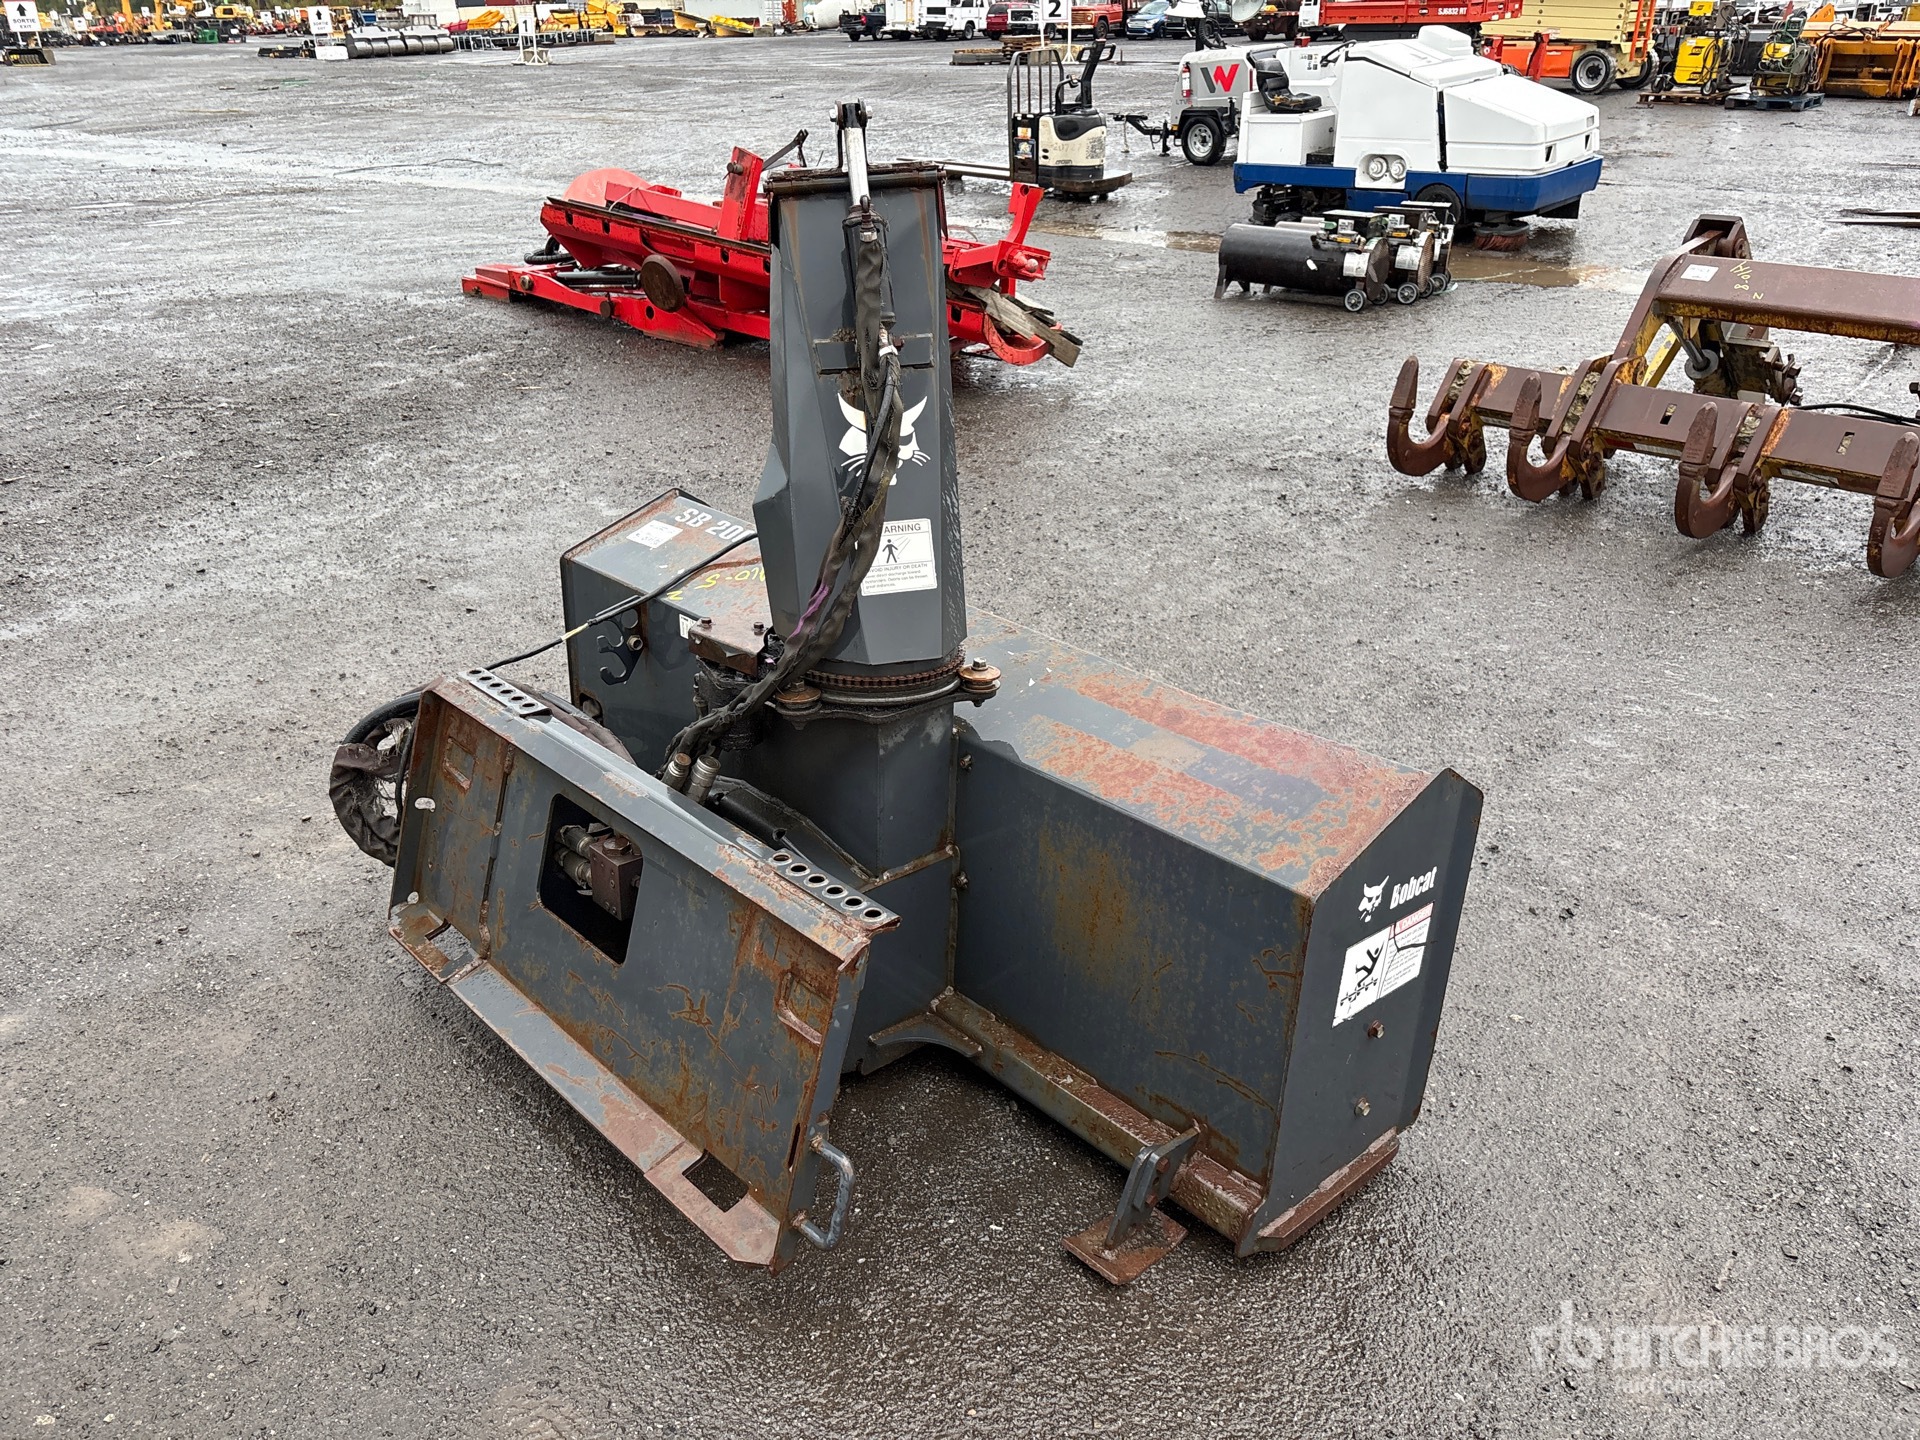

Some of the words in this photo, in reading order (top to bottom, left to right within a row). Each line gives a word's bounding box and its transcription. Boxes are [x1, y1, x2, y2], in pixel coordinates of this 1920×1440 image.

[1048, 0, 1062, 18] 2
[1437, 7, 1459, 16] SJ6832
[1459, 7, 1468, 15] RT
[522, 19, 529, 33] 1
[675, 508, 713, 528] SB
[884, 523, 921, 534] ARNING
[1389, 866, 1437, 910] Bobcat
